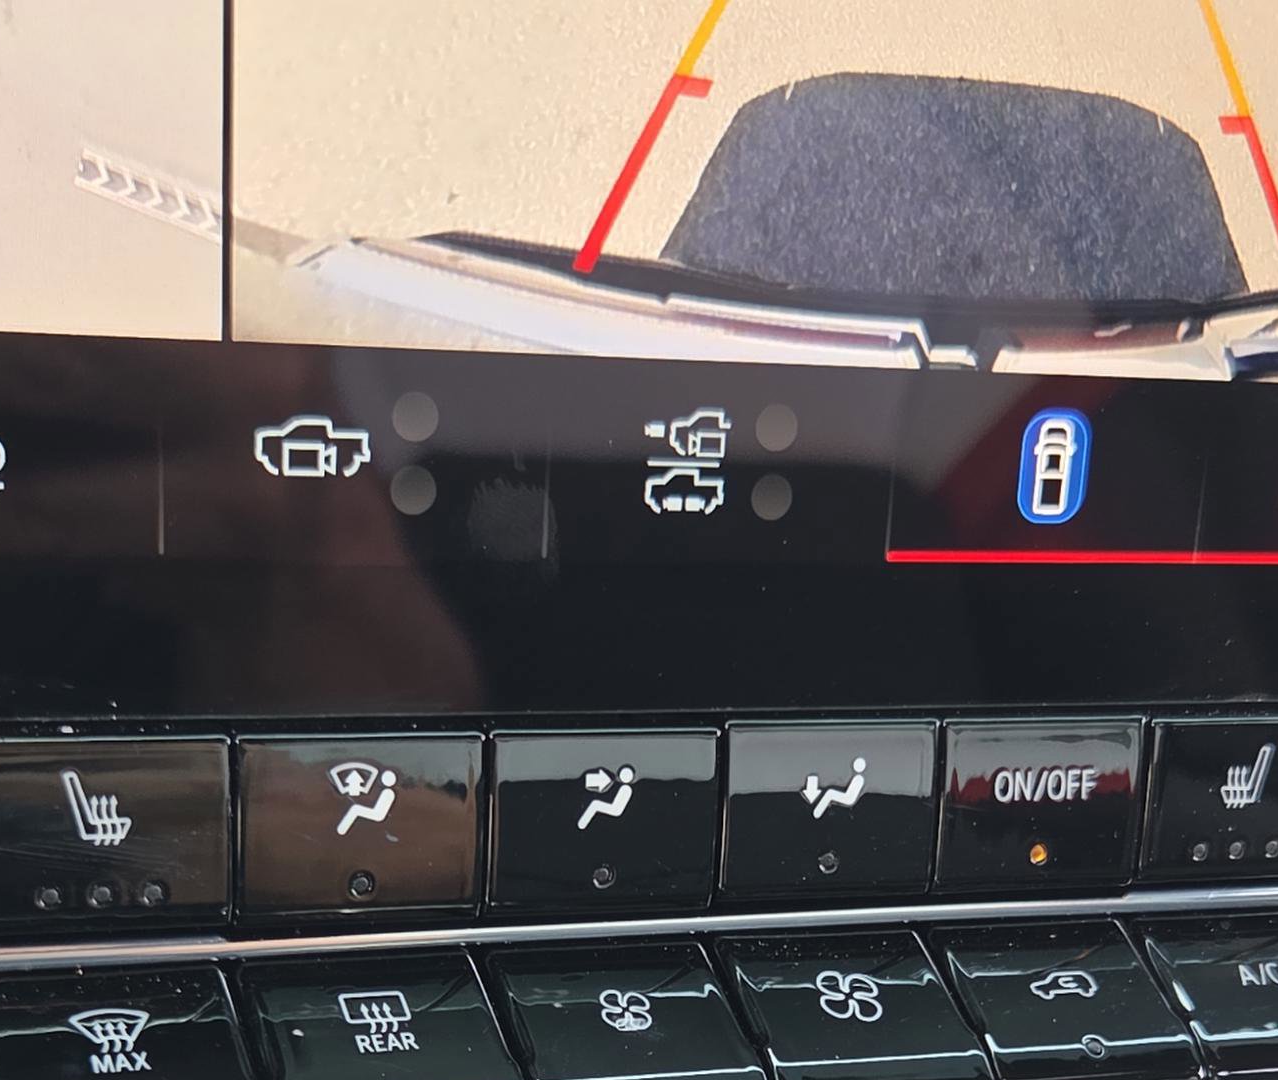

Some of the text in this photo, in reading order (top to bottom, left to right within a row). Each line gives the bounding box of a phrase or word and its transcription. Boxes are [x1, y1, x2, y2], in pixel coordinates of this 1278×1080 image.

[994, 768, 1097, 803] ON/OFF
[354, 1030, 420, 1054] REAR
[90, 1050, 151, 1073] MAX
